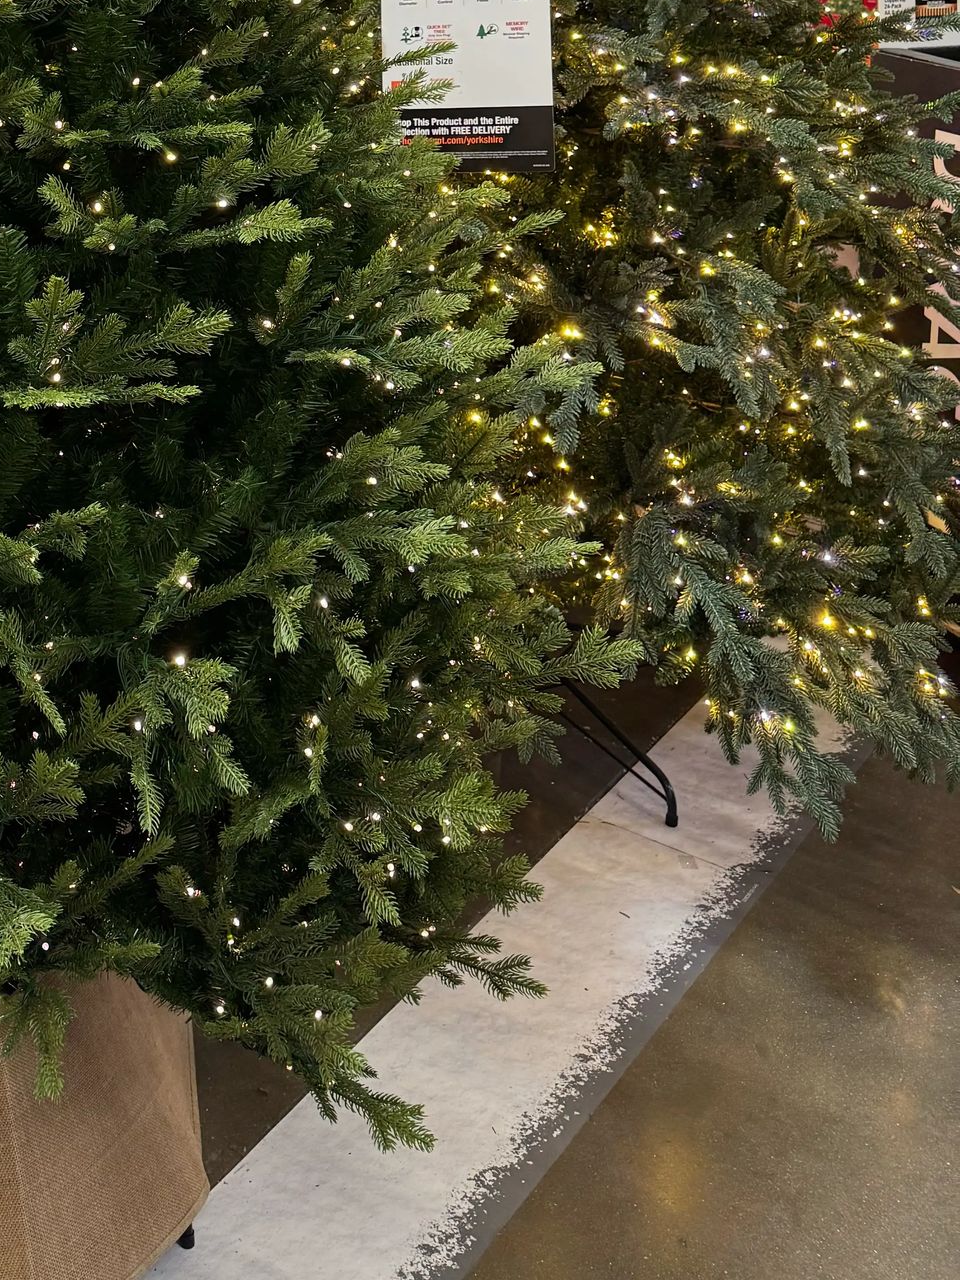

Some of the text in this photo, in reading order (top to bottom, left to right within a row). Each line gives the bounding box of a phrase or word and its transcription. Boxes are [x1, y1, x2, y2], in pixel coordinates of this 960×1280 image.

[435, 56, 454, 65] Size
[413, 117, 430, 126] This
[431, 117, 462, 126] Product
[480, 117, 493, 125] the
[495, 115, 519, 125] Entire
[432, 126, 449, 135] with
[451, 125, 471, 135] FREE
